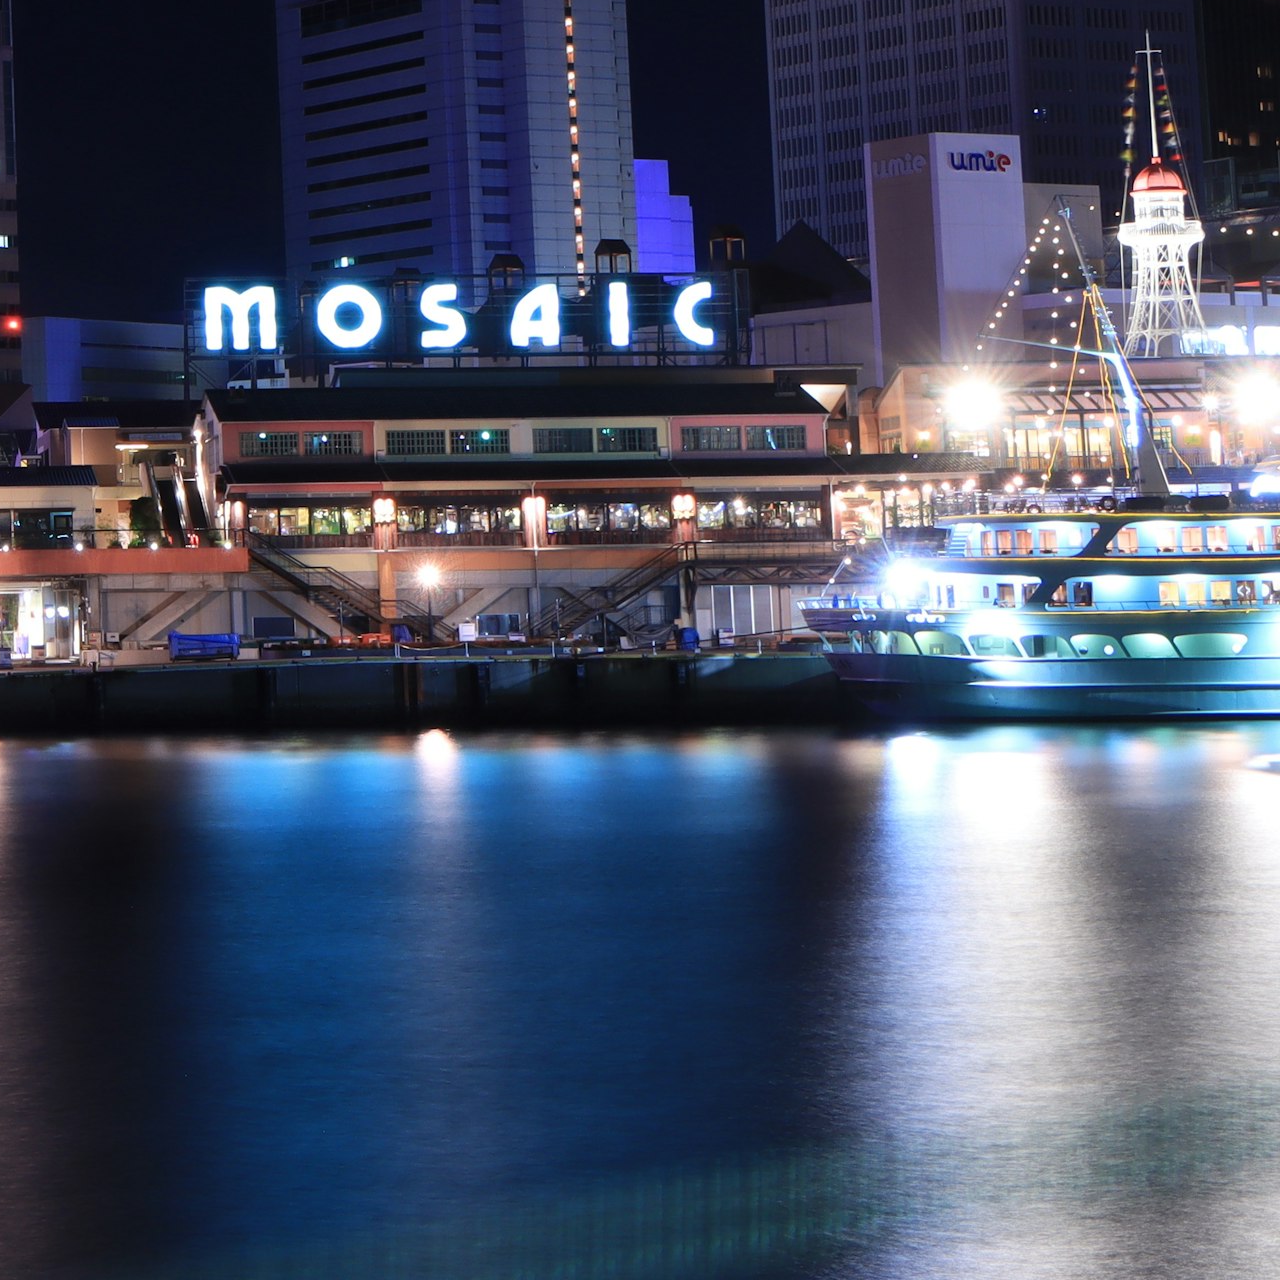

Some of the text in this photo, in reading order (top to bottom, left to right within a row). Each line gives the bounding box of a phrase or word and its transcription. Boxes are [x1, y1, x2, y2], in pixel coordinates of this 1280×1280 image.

[873, 153, 926, 177] umie
[949, 151, 1011, 172] umie
[204, 281, 715, 351] MOSAIC
